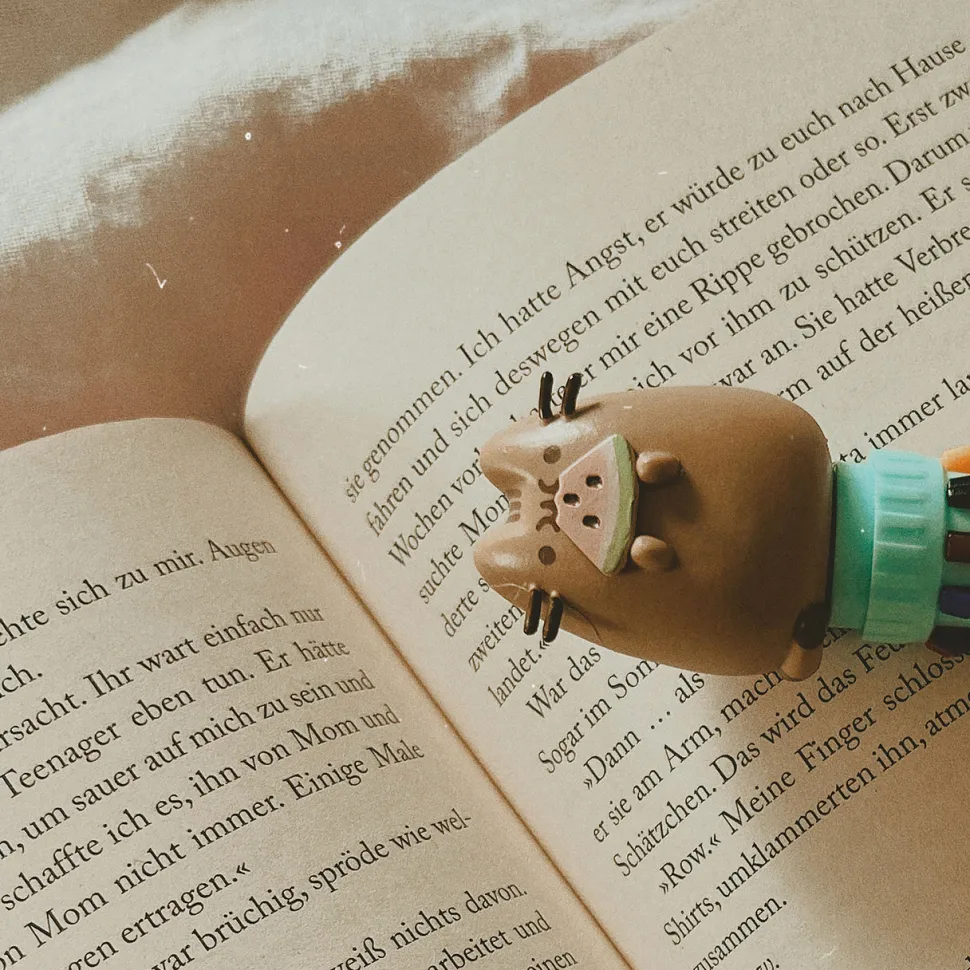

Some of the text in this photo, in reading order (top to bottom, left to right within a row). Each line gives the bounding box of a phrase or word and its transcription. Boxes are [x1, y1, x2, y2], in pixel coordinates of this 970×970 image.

[346, 40, 966, 503] sie genommen. Ich hatte Angst, er würde zu euch nach Hause
[365, 475, 414, 537] fahren
[410, 427, 450, 476] und
[451, 393, 494, 438] sich
[494, 310, 602, 396] deswegen
[604, 276, 648, 313] mit
[650, 236, 708, 281] euch
[710, 185, 798, 244] streiten
[799, 150, 850, 189] oder
[854, 136, 888, 158] so.
[882, 101, 938, 138] Erst
[816, 338, 856, 382] auf
[858, 320, 898, 352] der
[863, 393, 945, 450] immer
[54, 538, 276, 616] sich zu mir. Augen
[0, 640, 350, 799] Teenager eben tun. Er hätte
[592, 724, 722, 843] er sie am Arm,
[612, 668, 858, 878] Schätzchen. Das wird das
[23, 738, 425, 948] Mom nicht immer. Einige Male
[190, 808, 472, 952] brüchig, spröde wie wel-
[658, 707, 878, 894] »Row.« Meine Finger
[663, 896, 722, 946] Shirts,
[716, 766, 878, 898] umklammerten
[871, 735, 928, 773] ihn,
[389, 906, 462, 950] nichts
[463, 884, 528, 914] davon.
